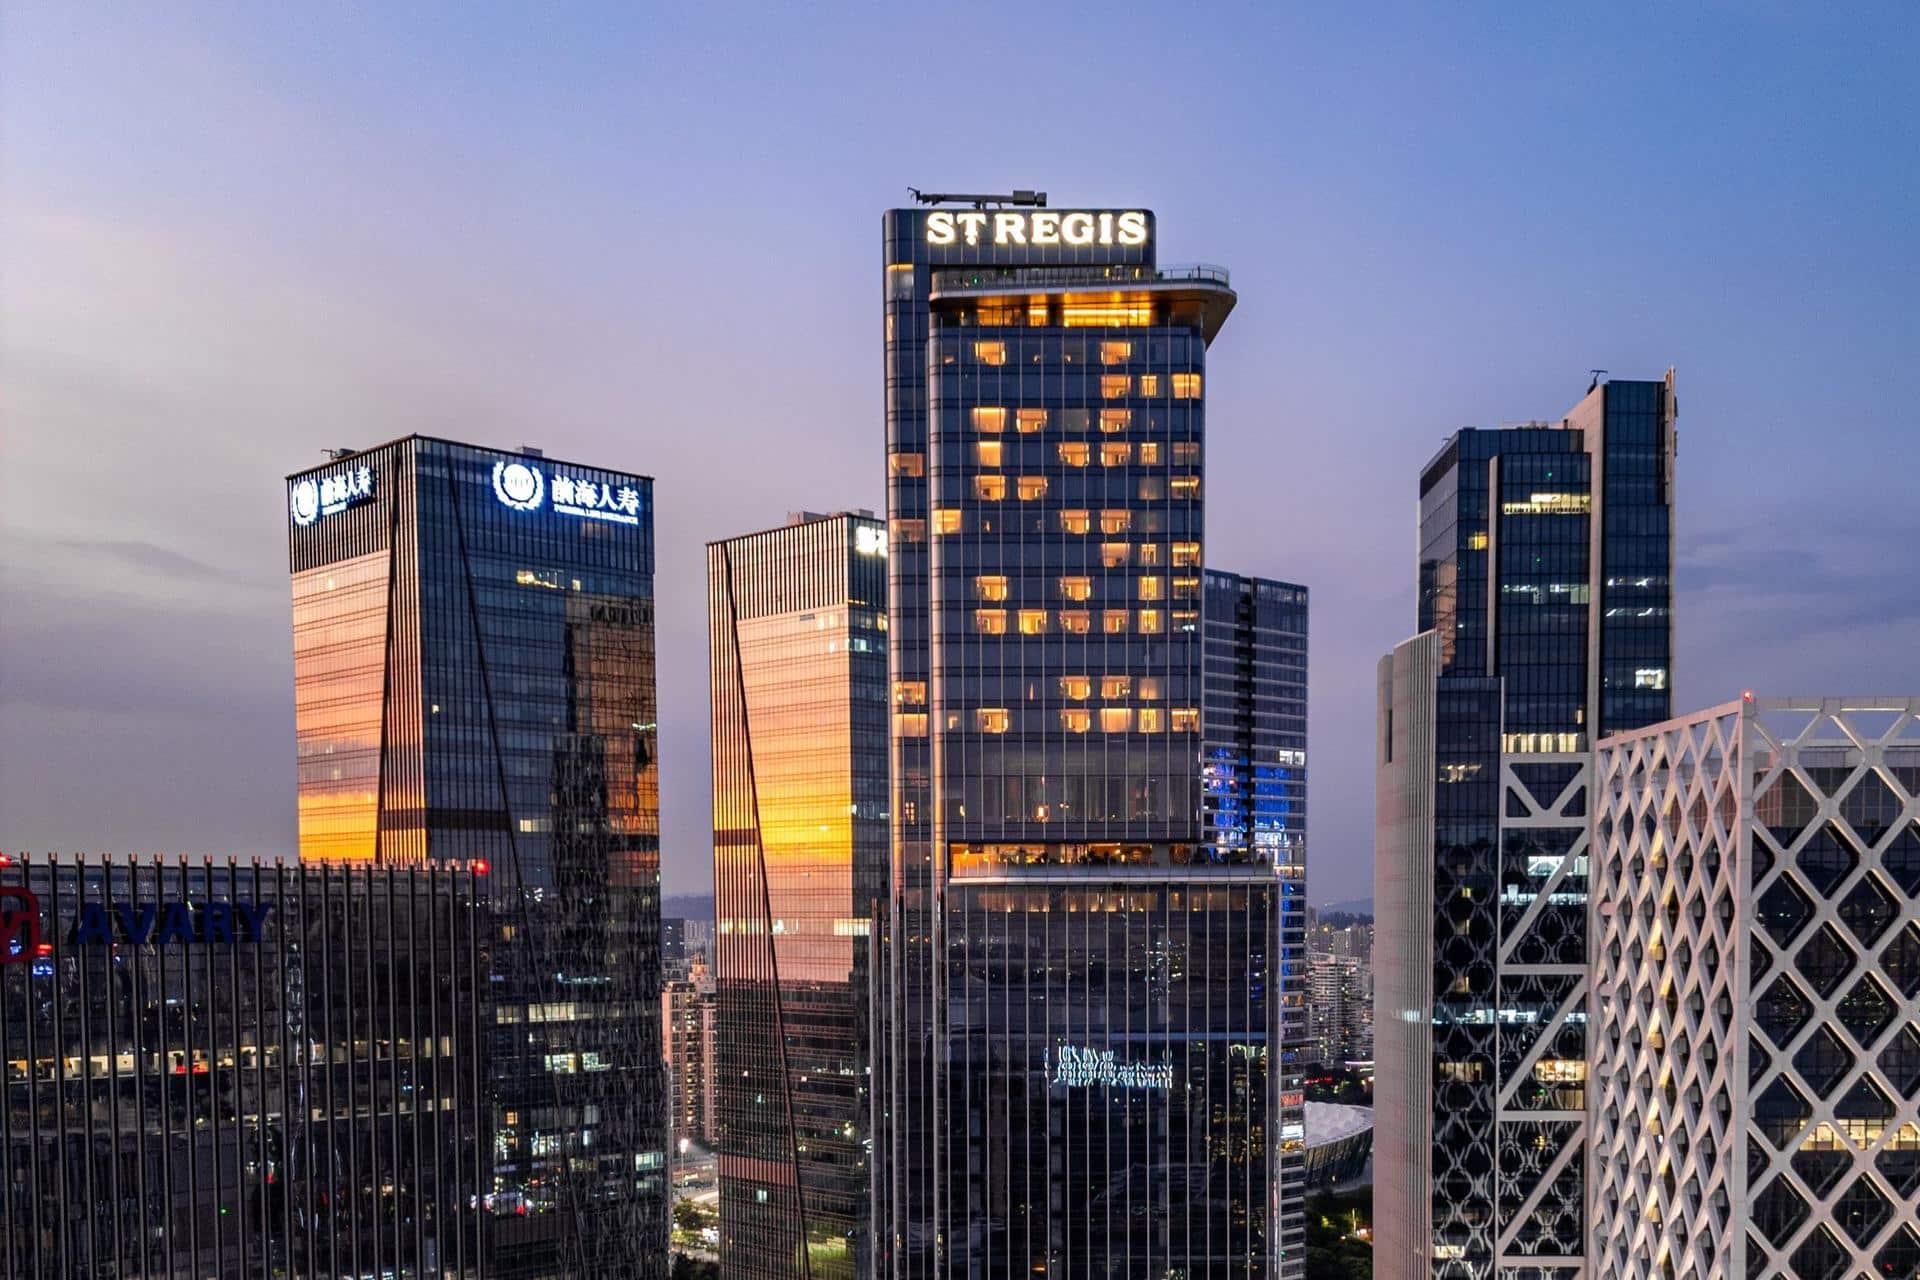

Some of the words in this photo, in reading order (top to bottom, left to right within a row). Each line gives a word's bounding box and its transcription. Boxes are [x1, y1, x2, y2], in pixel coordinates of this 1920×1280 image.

[994, 212, 1147, 244] REGIS
[551, 474, 640, 515] 前海人寿
[78, 902, 270, 944] AVARY
